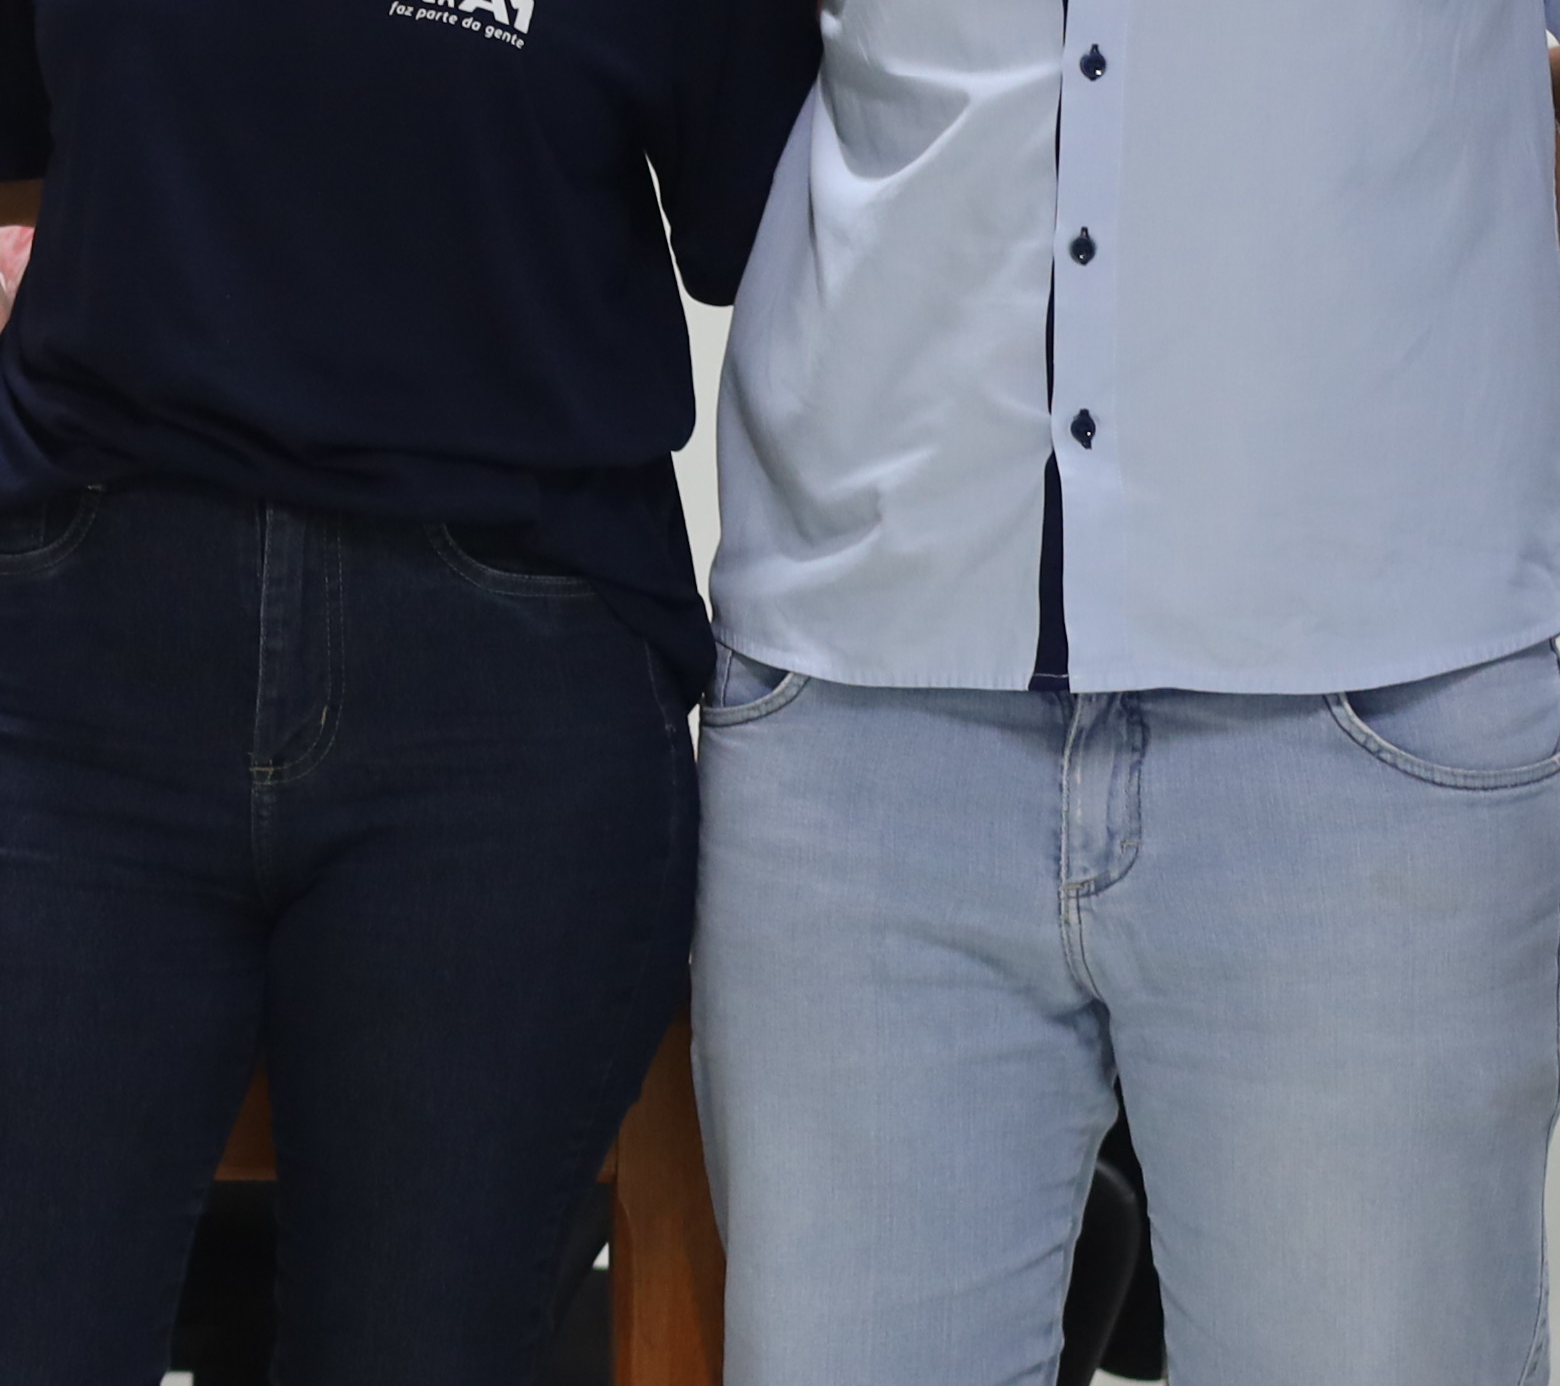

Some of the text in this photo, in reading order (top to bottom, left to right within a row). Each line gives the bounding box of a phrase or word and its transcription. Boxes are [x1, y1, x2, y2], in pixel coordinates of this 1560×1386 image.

[389, 1, 525, 49] faz parte da gente
